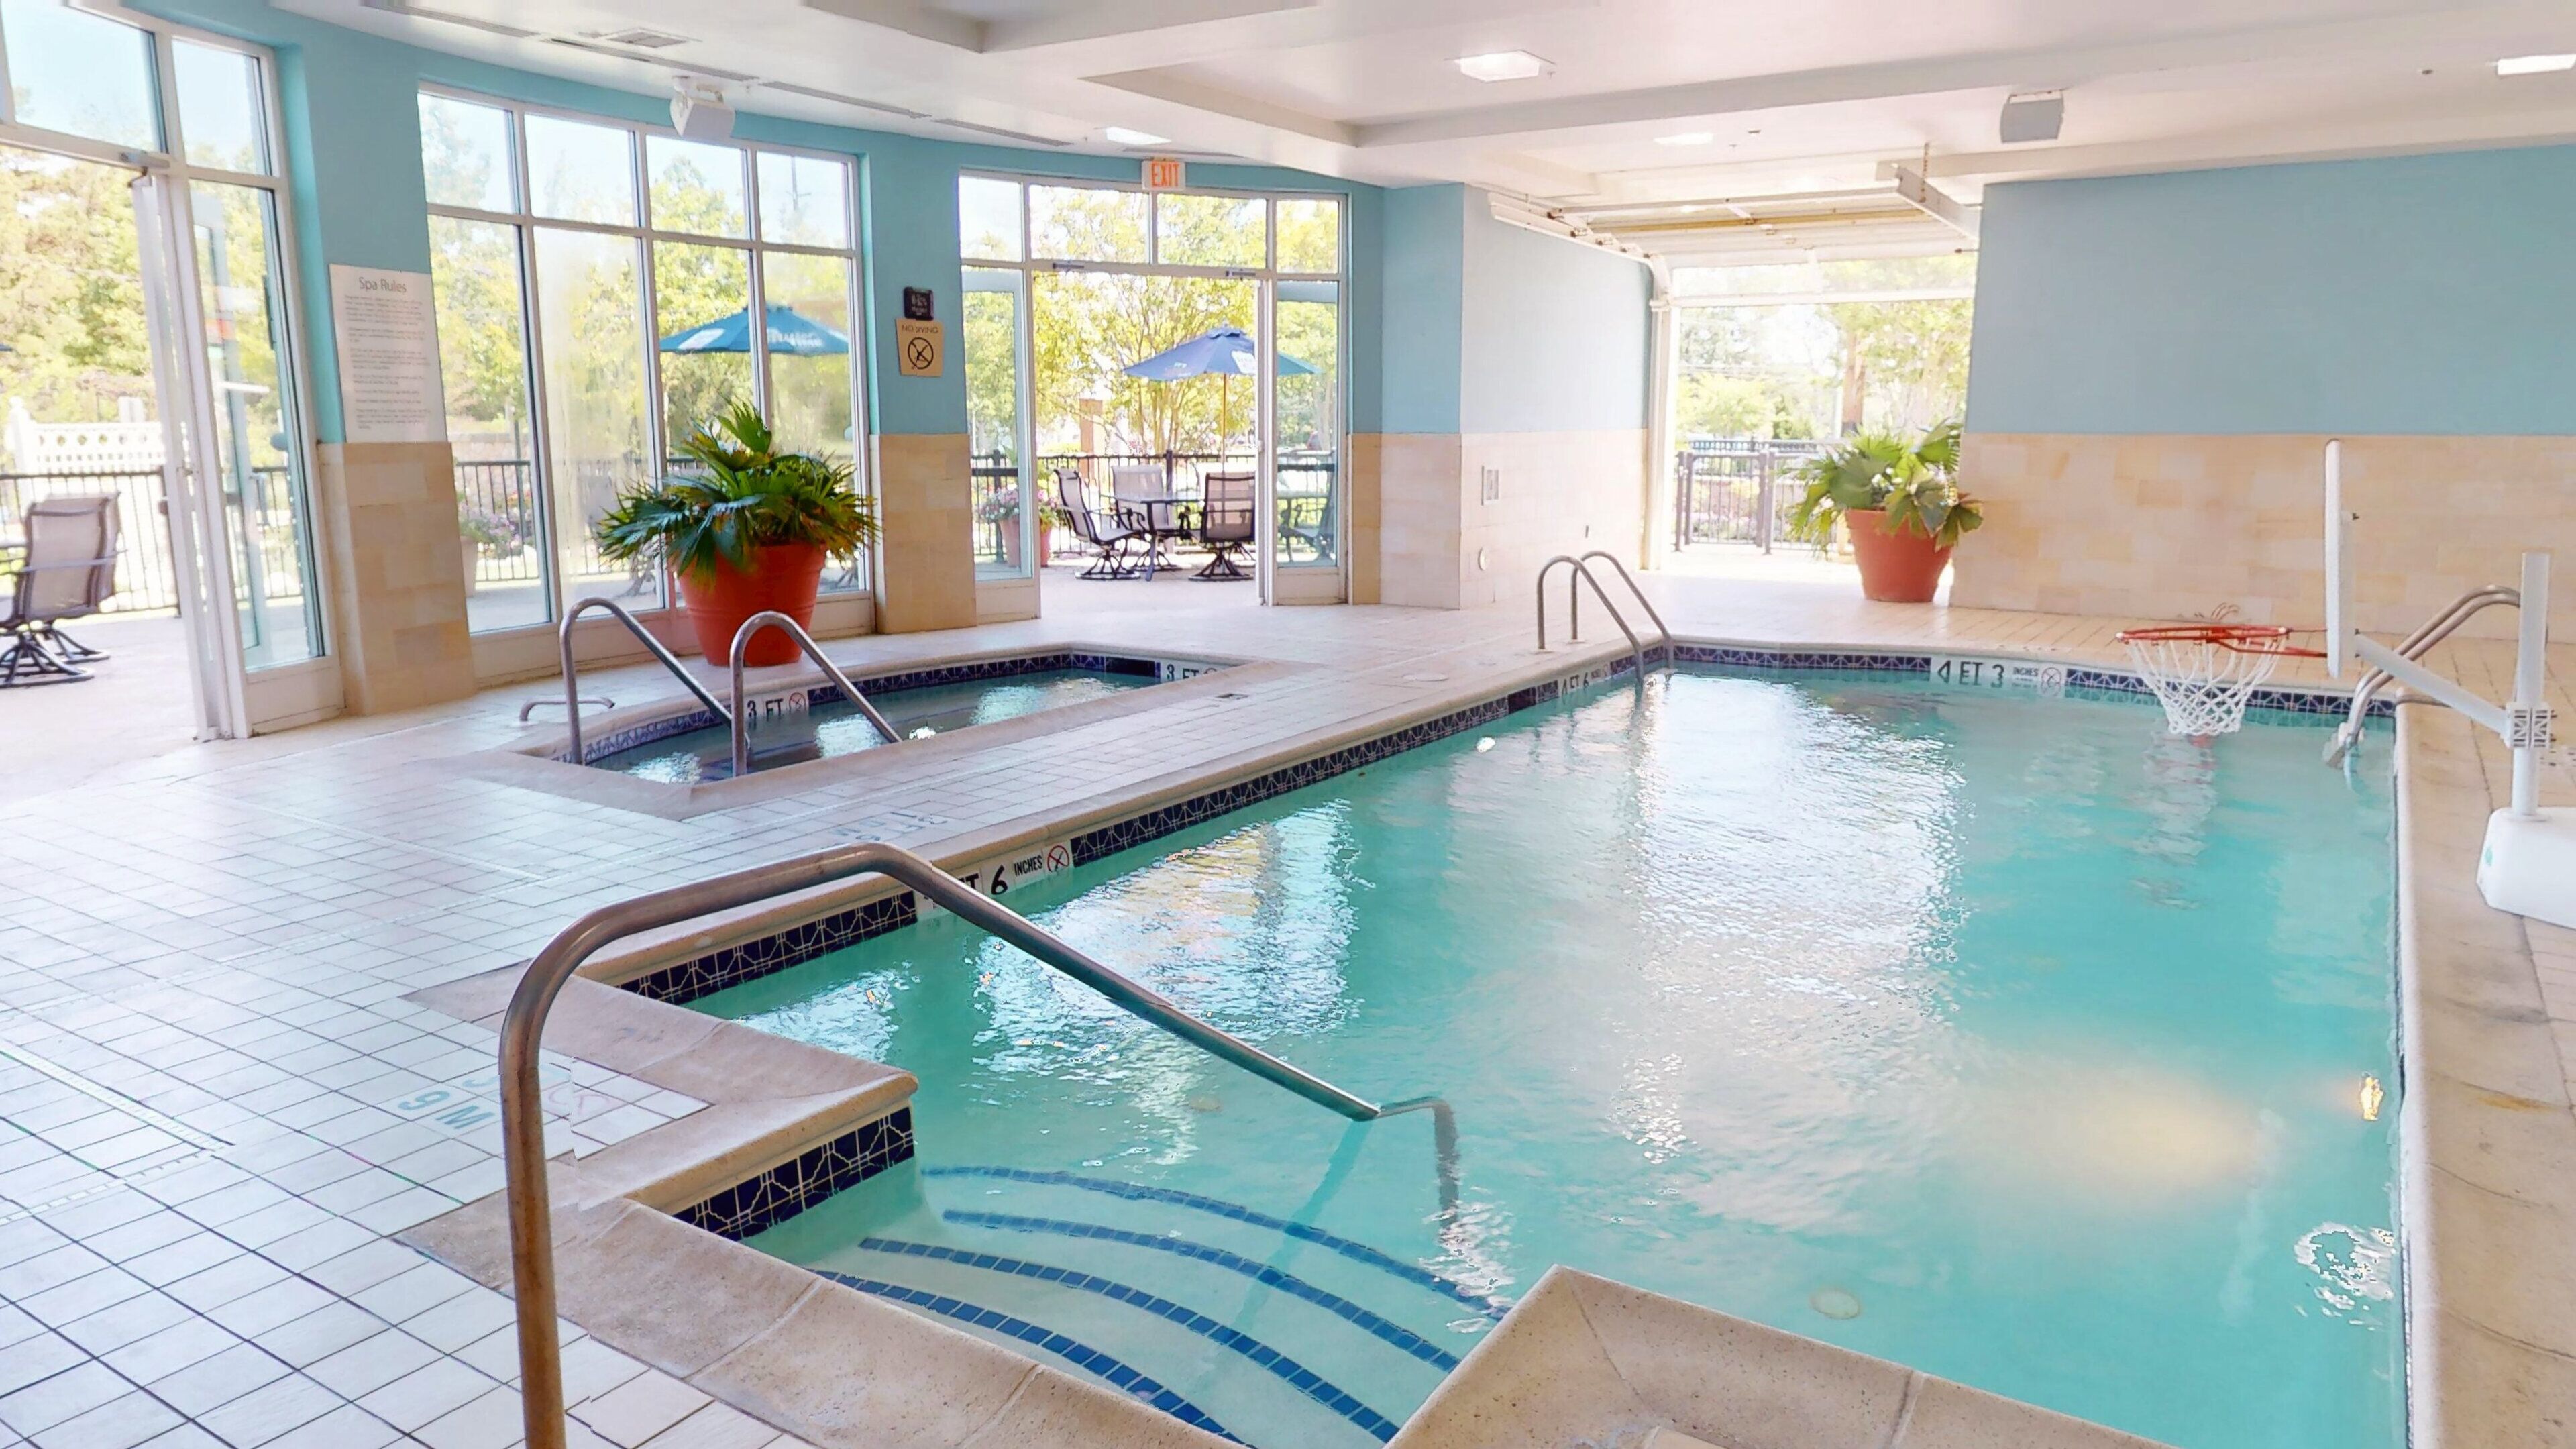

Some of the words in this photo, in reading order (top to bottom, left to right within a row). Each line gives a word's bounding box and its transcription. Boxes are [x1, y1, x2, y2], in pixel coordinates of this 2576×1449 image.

[1151, 163, 1179, 186] EXIT
[358, 276, 378, 291] Spa
[380, 278, 407, 294] Rules
[1166, 663, 1175, 681] 3
[747, 700, 757, 717] 3
[765, 698, 784, 721] FT
[991, 865, 1009, 895] 6
[1014, 854, 1043, 877] INCHES
